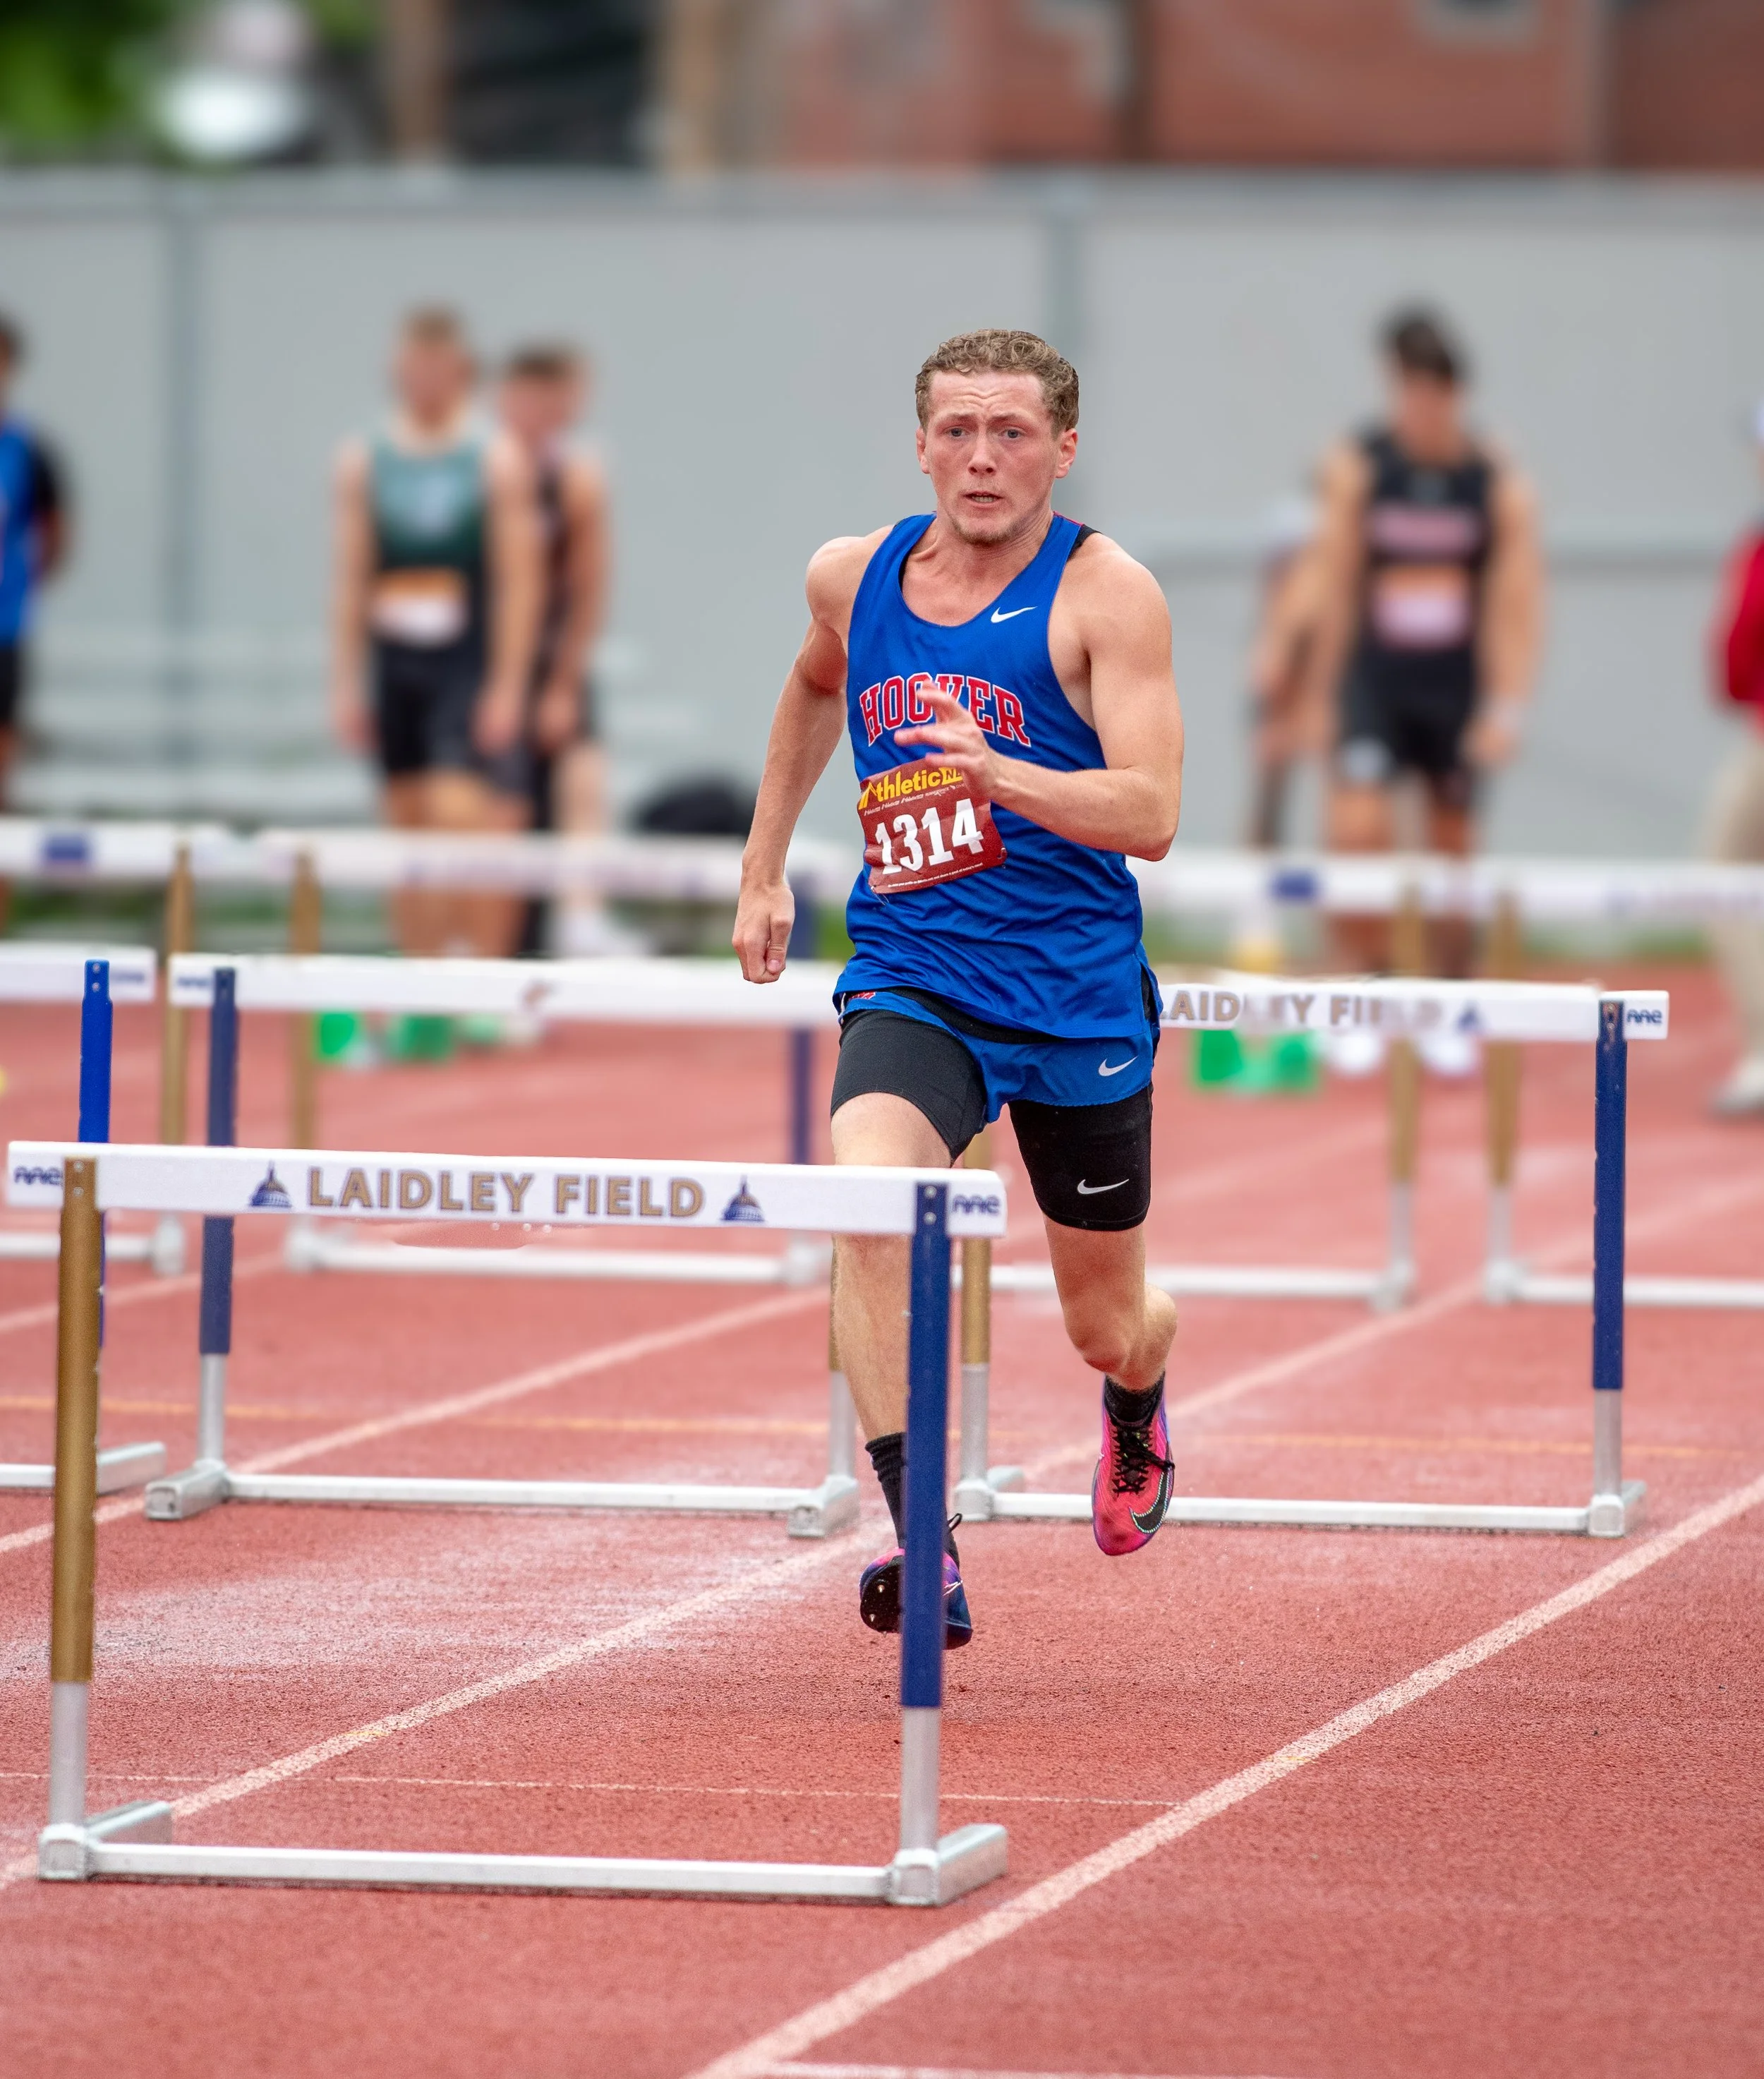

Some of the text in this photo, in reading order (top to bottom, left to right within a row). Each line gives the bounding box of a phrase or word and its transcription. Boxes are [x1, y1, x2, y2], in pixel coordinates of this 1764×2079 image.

[875, 798, 984, 875] 1314
[308, 1167, 705, 1217] LAIDLEY FIELD
